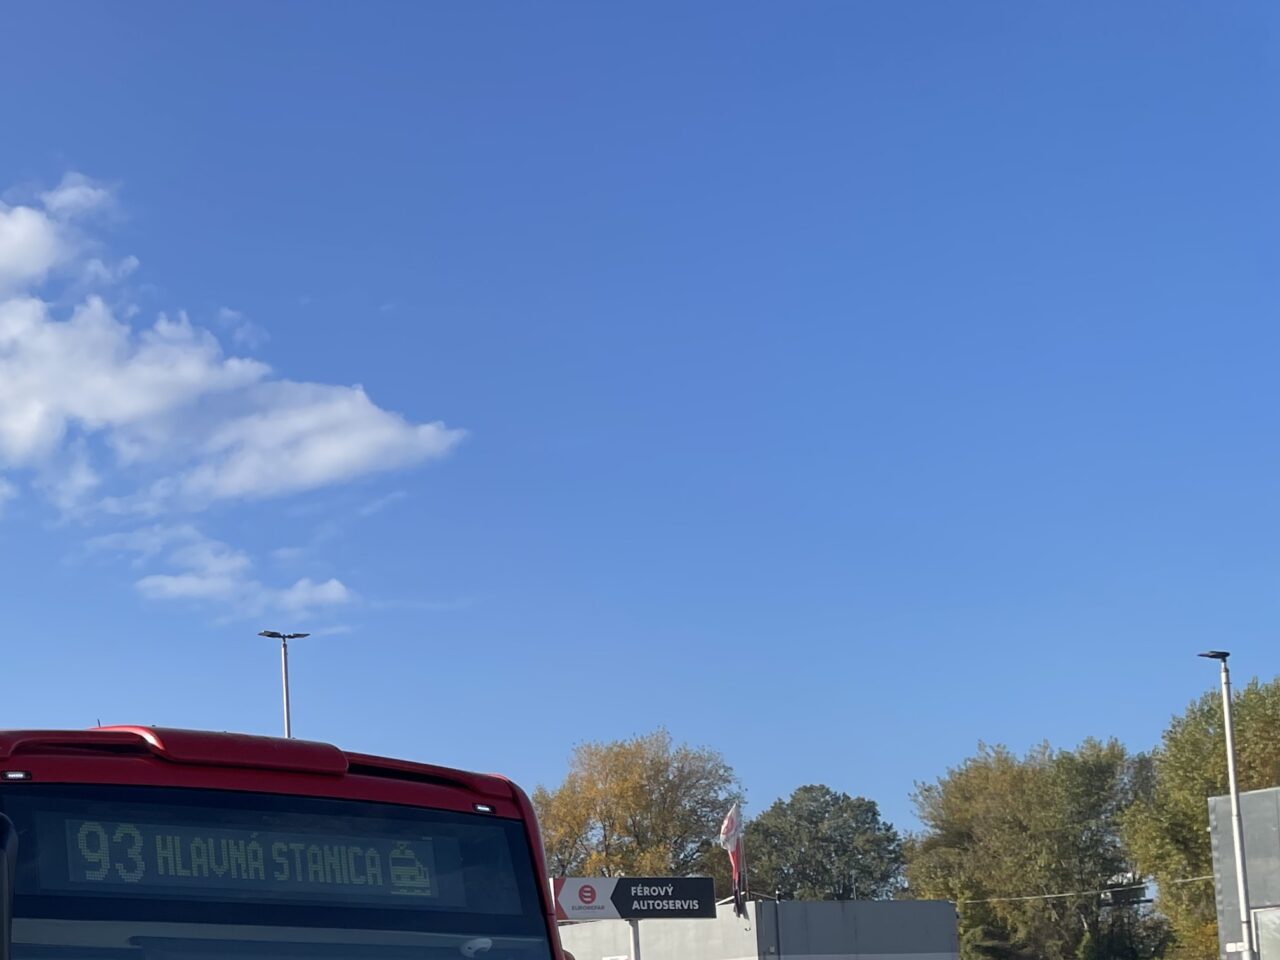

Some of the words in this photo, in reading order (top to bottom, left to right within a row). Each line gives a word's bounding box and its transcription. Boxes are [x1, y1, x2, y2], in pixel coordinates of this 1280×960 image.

[77, 821, 145, 883] 93
[155, 832, 266, 881] HLAVNÁ
[272, 841, 384, 887] STANICA
[631, 883, 674, 897] FÉROVÝ
[632, 899, 700, 911] AUTOSERVIS
